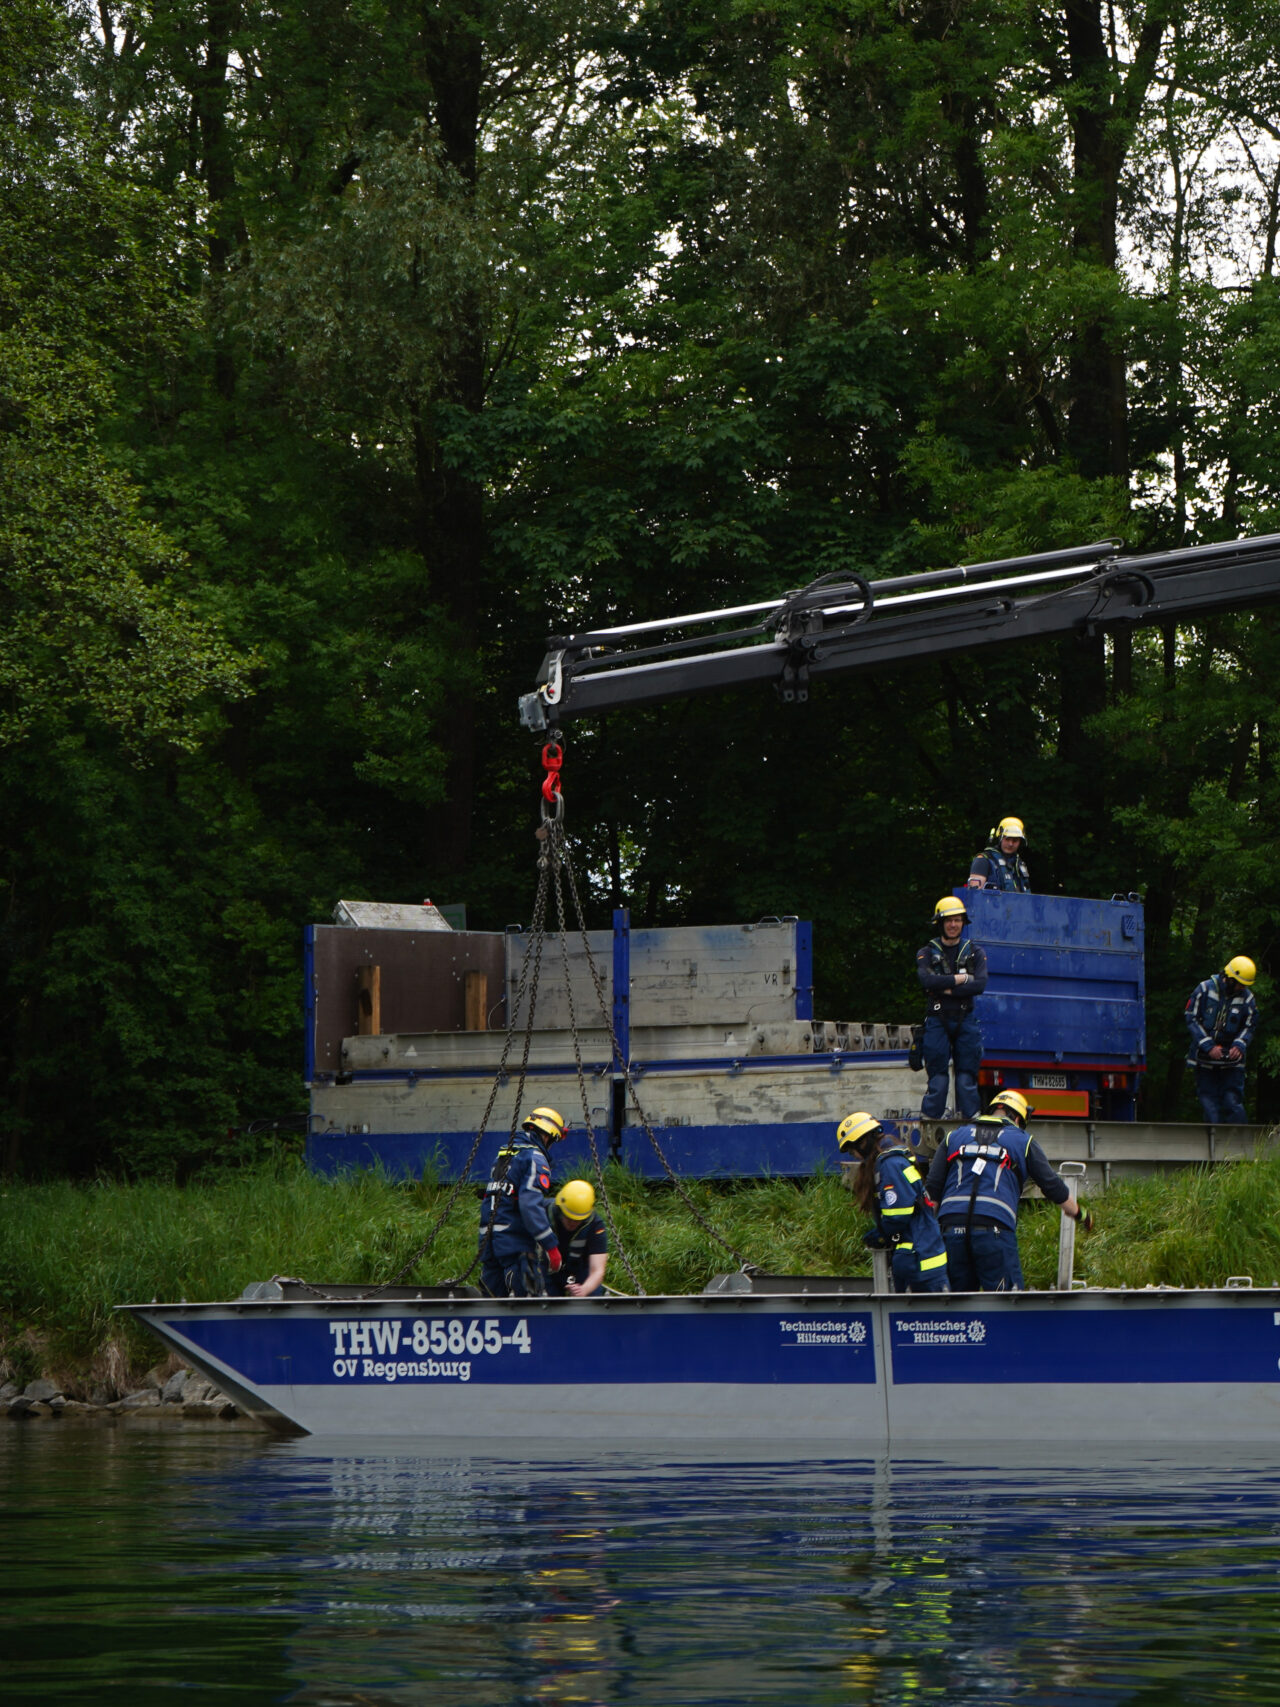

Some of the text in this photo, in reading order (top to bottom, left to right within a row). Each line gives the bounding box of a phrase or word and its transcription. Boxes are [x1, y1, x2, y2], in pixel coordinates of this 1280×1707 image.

[779, 1320, 847, 1332] Technisches
[896, 1320, 966, 1332] Technisches
[329, 1319, 532, 1355] THW-85865-4
[796, 1332, 848, 1344] Hilfswerk
[913, 1332, 967, 1344] Hilfswerk
[333, 1359, 471, 1381] OV Regensburg
